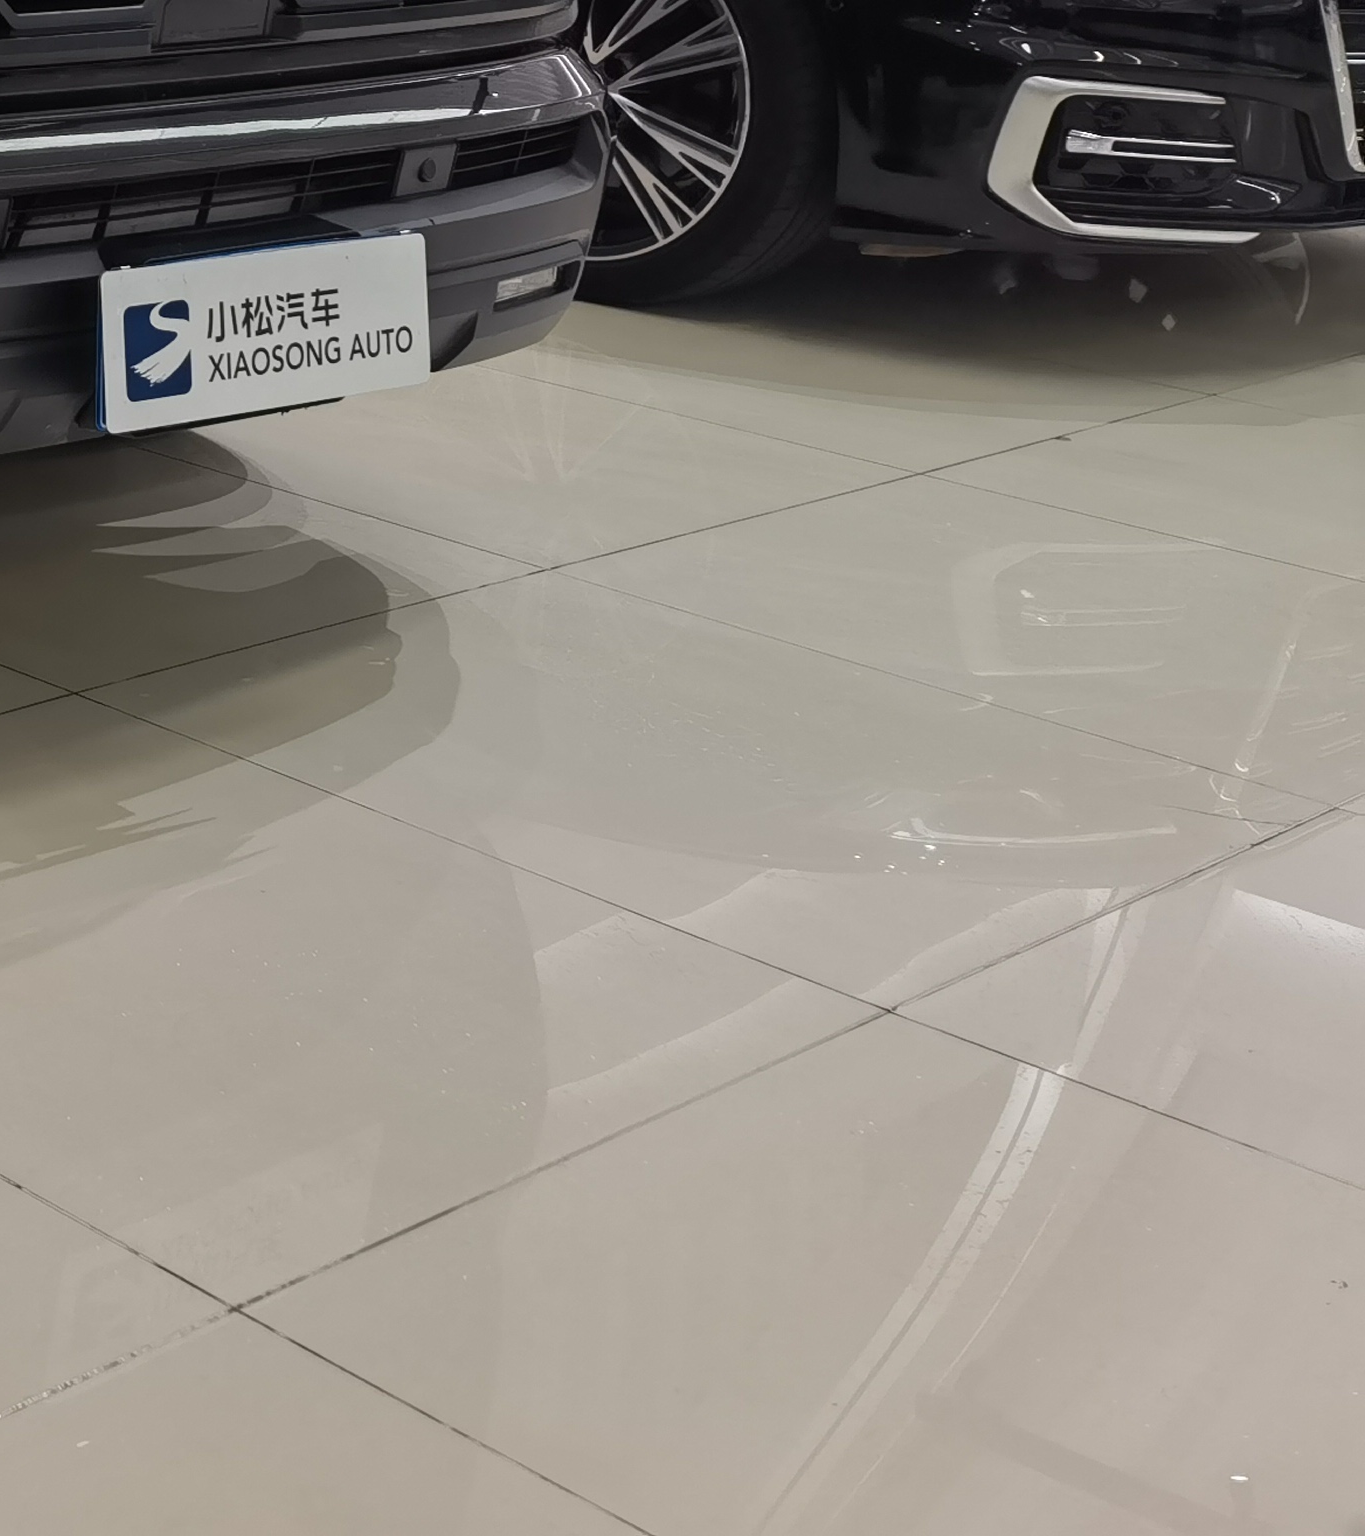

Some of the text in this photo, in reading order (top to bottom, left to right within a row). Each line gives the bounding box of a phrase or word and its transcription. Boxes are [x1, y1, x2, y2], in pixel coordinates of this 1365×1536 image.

[206, 288, 341, 343] 小松汽车
[207, 325, 413, 383] XIAOSONG AUTO
